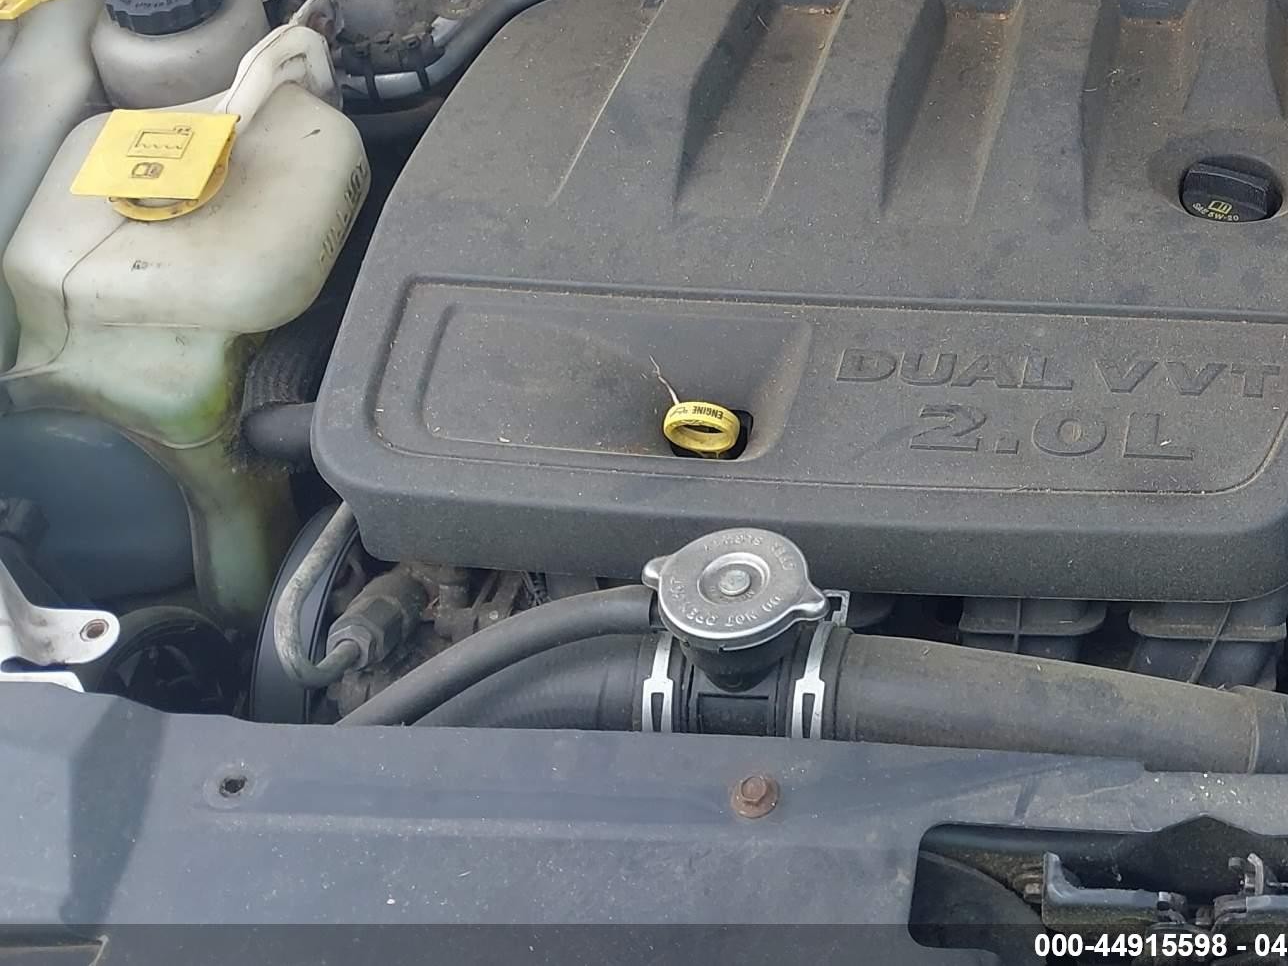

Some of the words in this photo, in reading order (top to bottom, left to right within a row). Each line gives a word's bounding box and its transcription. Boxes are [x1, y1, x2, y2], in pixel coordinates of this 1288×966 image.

[1192, 202, 1210, 215] SAE
[1207, 212, 1240, 222] 5W-20
[835, 347, 1074, 392] DUAL
[1095, 357, 1281, 398] VVT
[691, 405, 724, 420] ENGINE
[910, 403, 1195, 461] 2.0L
